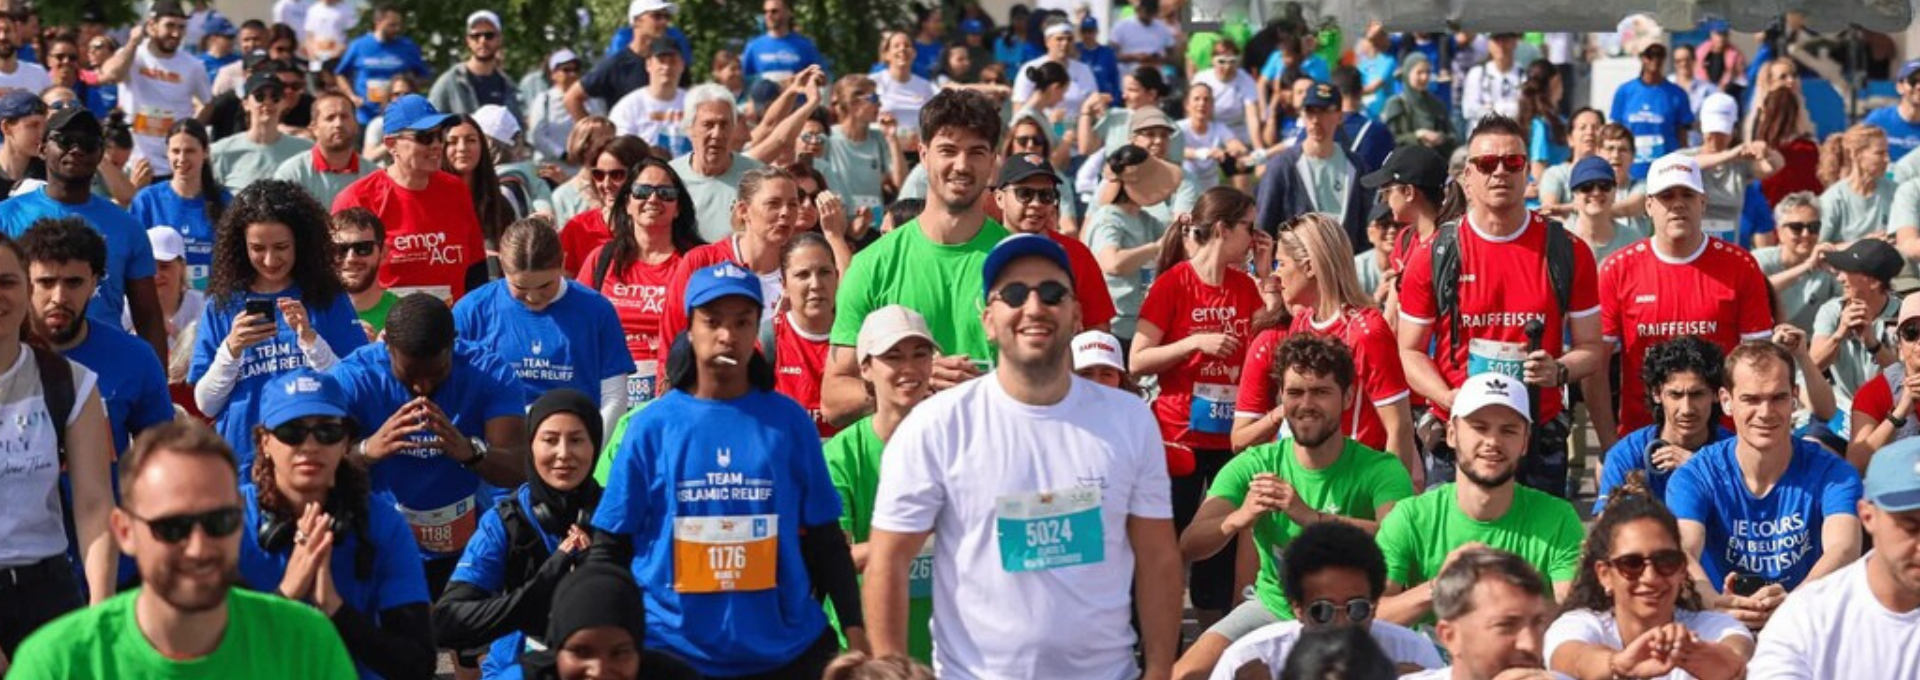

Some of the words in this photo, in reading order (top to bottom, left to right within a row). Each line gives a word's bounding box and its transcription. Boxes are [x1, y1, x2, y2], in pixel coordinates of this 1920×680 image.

[429, 244, 463, 265] ACT
[641, 298, 666, 314] AC
[1223, 318, 1249, 337] ACT
[1637, 320, 1718, 337] RAIFFEISEN
[255, 343, 291, 359] TEAM
[240, 360, 278, 378] LAMIC
[523, 358, 550, 369] TEAM
[515, 369, 540, 379] AMIC
[540, 370, 574, 381] RELIEF
[706, 472, 743, 485] TEAM
[731, 487, 773, 500] RELIEF
[420, 525, 452, 541] 1188
[1025, 518, 1073, 547] 5024
[1747, 540, 1777, 553] BEU
[707, 546, 747, 570] 1176
